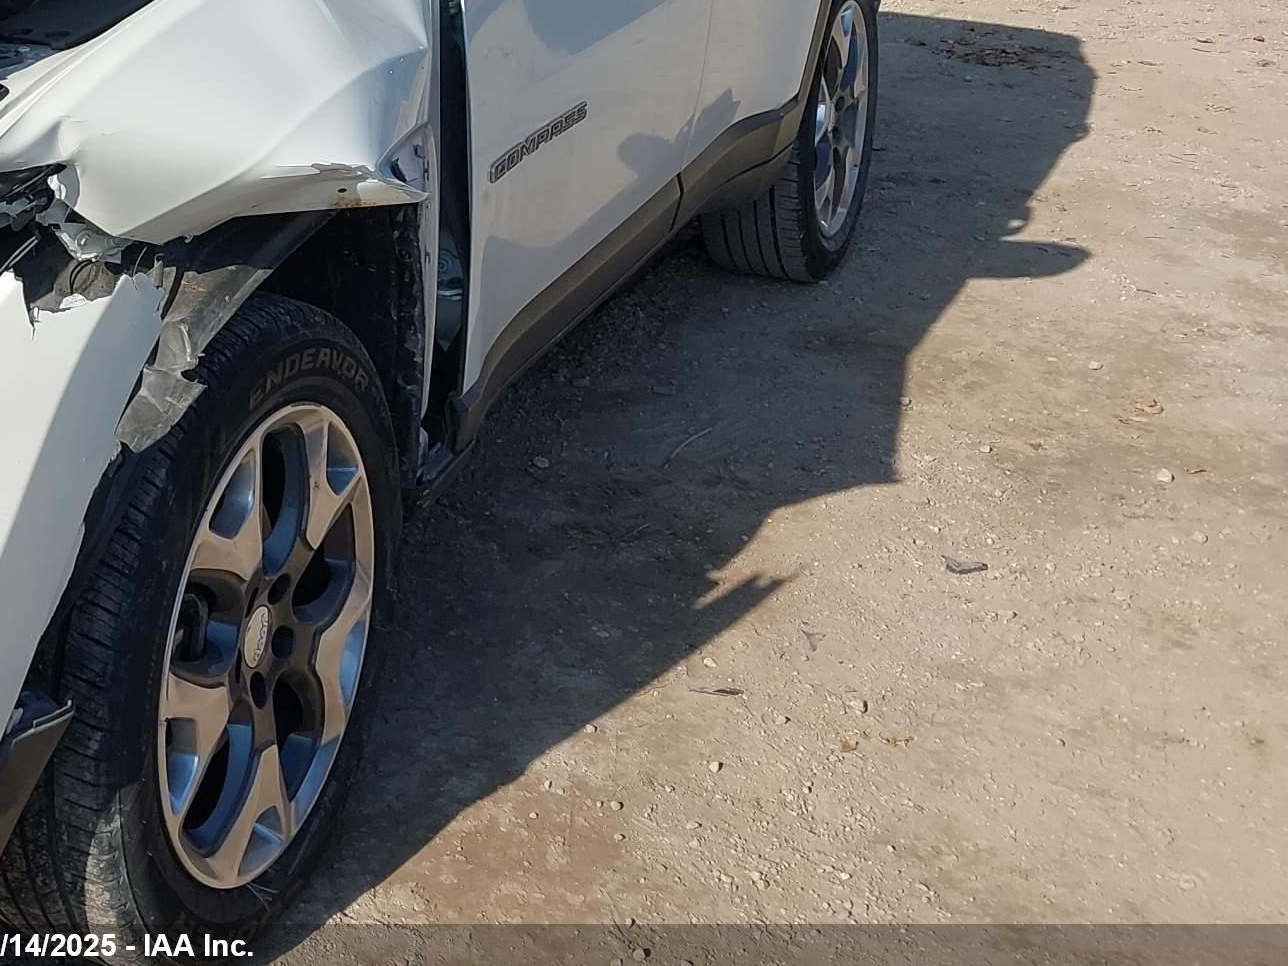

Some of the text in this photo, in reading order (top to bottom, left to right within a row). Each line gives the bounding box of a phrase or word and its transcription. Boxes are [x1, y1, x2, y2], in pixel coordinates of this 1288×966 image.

[488, 101, 588, 184] COMPASS
[248, 346, 370, 411] ENDEAVOR
[253, 612, 269, 662] Jeep
